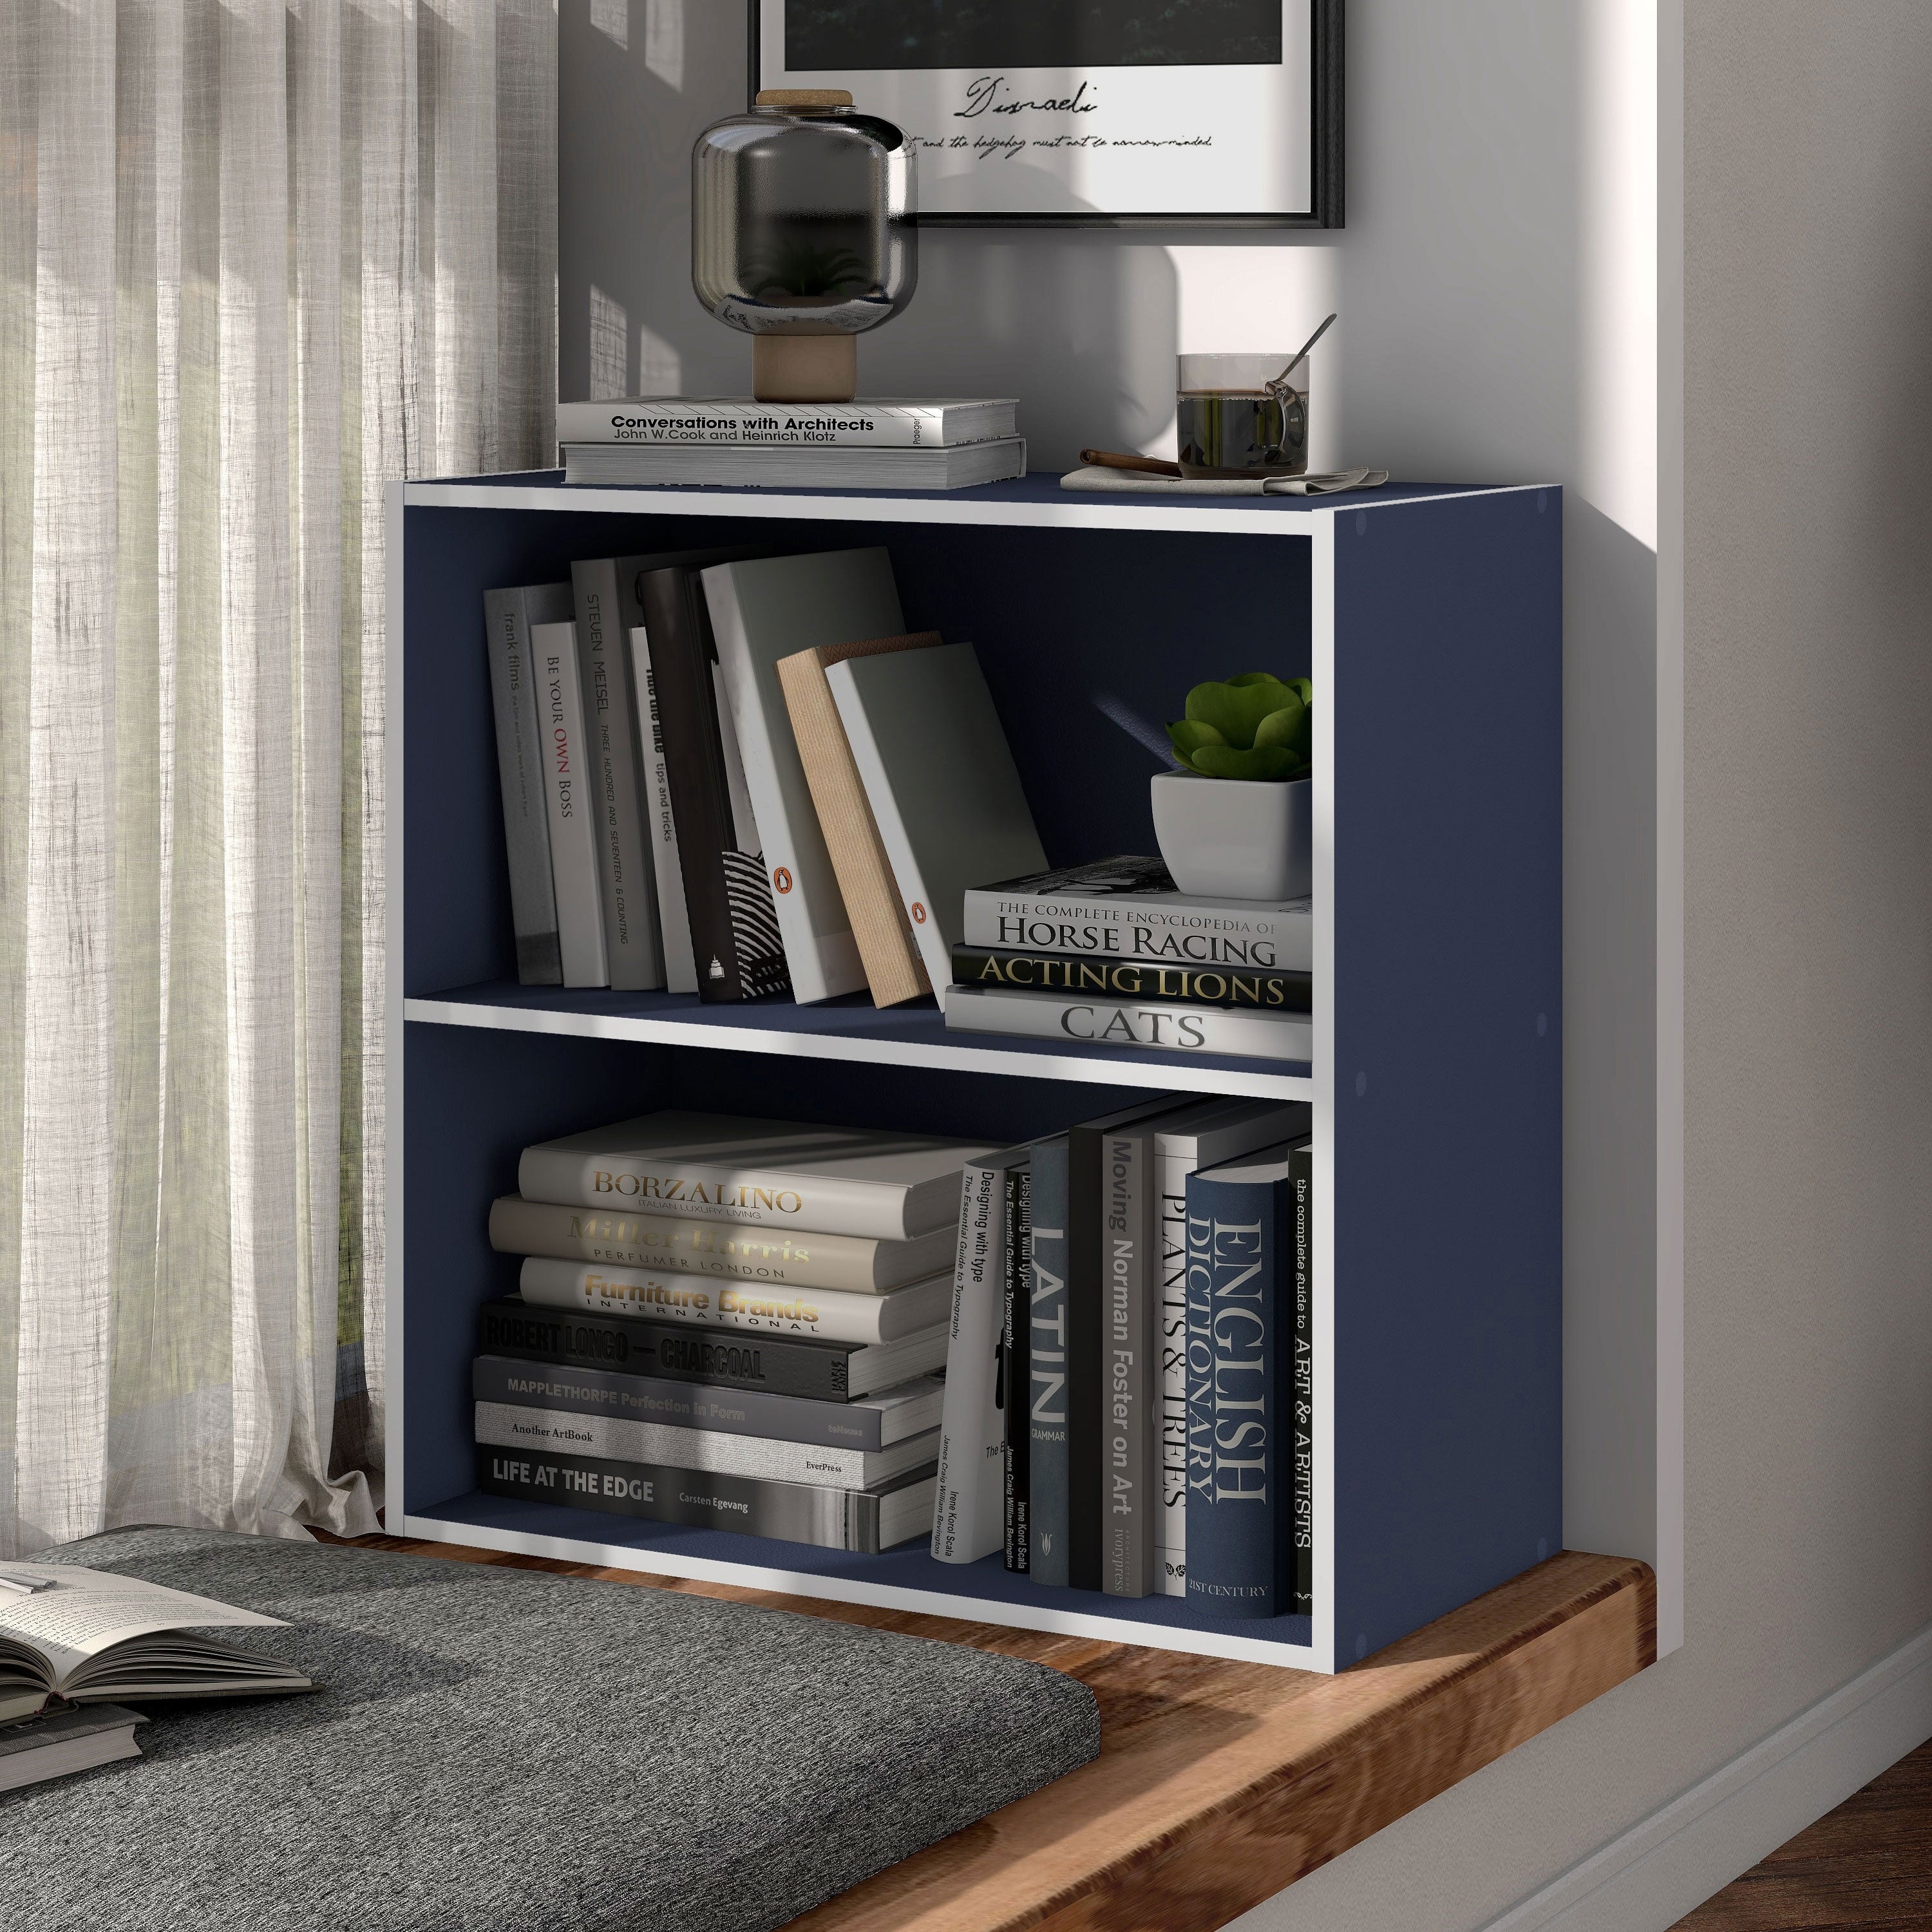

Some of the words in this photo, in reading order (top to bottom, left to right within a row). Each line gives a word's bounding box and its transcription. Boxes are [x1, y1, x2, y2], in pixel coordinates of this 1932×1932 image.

[923, 138, 944, 147] and
[948, 135, 969, 148] the
[974, 135, 1027, 160] hedgehog
[611, 415, 737, 429] Conversations
[743, 417, 779, 430] with
[784, 417, 874, 431] Architects
[614, 428, 647, 439] John
[651, 429, 706, 440] W.Cook
[710, 430, 737, 440] and
[742, 430, 799, 441] Heinrich
[804, 431, 837, 442] Klotz
[913, 418, 923, 445] Praeger
[504, 613, 518, 650] frank
[587, 593, 603, 652] STEVEN
[508, 654, 520, 691] films
[547, 656, 560, 674] BE
[549, 679, 564, 724] YOUR
[593, 661, 609, 716] MEISEL
[553, 728, 570, 773] OWN
[601, 724, 611, 753] THREE
[656, 762, 665, 784] tips
[558, 780, 573, 818] BOSS
[659, 787, 669, 807] and
[608, 806, 617, 826] AND
[662, 811, 672, 842] tricks
[610, 829, 622, 884] SEVENTEEN
[997, 902, 1029, 914] THE
[1035, 904, 1119, 922] COMPLETE
[1126, 911, 1251, 933] ENCYCLOPEDIA
[1256, 922, 1278, 935] OF
[997, 916, 1120, 952] HORSE
[1131, 926, 1277, 967] RACING
[977, 955, 1142, 993] ACTING
[1156, 969, 1285, 1005] LIONS
[1060, 1006, 1206, 1048] CATS
[592, 1171, 802, 1213] BORZALINO
[965, 1175, 973, 1193] The
[1108, 1141, 1132, 1232] Moving
[1296, 1179, 1306, 1202] the
[638, 1199, 677, 1210] ITALIAN
[680, 1203, 723, 1215] LUXURY
[726, 1208, 761, 1219] LIVING
[975, 1171, 995, 1229] Designing
[961, 1195, 971, 1239] Essential
[567, 1215, 679, 1248] Miller
[689, 1227, 810, 1264] Harris
[974, 1231, 989, 1255] with
[1296, 1205, 1306, 1269] complete
[594, 1249, 690, 1268] PERFUMER
[701, 1261, 785, 1278] LONDON
[958, 1240, 967, 1269] Guide
[971, 1258, 987, 1282] type
[1006, 1248, 1014, 1276] Guide
[1162, 1191, 1186, 1338] PLANTS
[957, 1271, 963, 1281] to
[1006, 1278, 1012, 1289] to
[1113, 1239, 1133, 1341] Norman
[585, 1274, 709, 1309] Furniture
[718, 1289, 819, 1323] Brands
[1296, 1272, 1305, 1315] guide
[586, 1298, 820, 1332] INTERNATIONAL
[950, 1284, 963, 1340] Typography
[1005, 1291, 1014, 1349] Typography
[1031, 1226, 1066, 1423] LATIN
[1296, 1316, 1305, 1329] to
[487, 1316, 562, 1353] ROBERT
[565, 1325, 629, 1362] LONGO
[660, 1338, 766, 1383] CHARCOAL
[1162, 1347, 1186, 1377] &
[1188, 1213, 1213, 1505] DICTIONARY
[1214, 1217, 1267, 1505] ENGLISH
[507, 1378, 618, 1405] MAPPLETHORPE
[621, 1392, 690, 1414] Perfection
[694, 1401, 706, 1416] in
[710, 1404, 746, 1421] Form
[1113, 1349, 1133, 1430] Foster
[1296, 1400, 1311, 1424] &
[511, 1423, 551, 1437] Another
[552, 1427, 593, 1442] ArtBook
[942, 1435, 951, 1461] James
[1031, 1428, 1066, 1441] GRAMMAR
[1162, 1388, 1186, 1508] TREES
[806, 1461, 842, 1473] EverPress
[986, 1444, 999, 1459] The
[1113, 1436, 1128, 1467] on
[493, 1458, 531, 1484] LIFE
[534, 1464, 558, 1488] AT
[562, 1469, 598, 1495] THE
[603, 1475, 654, 1502] EDGE
[1006, 1473, 1014, 1496] Craig
[1113, 1473, 1133, 1515] Art
[1295, 1431, 1311, 1549] ARTISTS
[679, 1492, 711, 1506] Carsten
[712, 1497, 748, 1514] Egevang
[938, 1485, 947, 1514] William
[949, 1491, 959, 1511] Irene
[1006, 1497, 1014, 1526] William
[1018, 1501, 1027, 1522] Irene
[934, 1515, 943, 1554] Bevington
[947, 1513, 957, 1533] Korol
[1018, 1523, 1027, 1545] Korol
[945, 1535, 954, 1557] Scala
[1006, 1528, 1014, 1567] Bevington
[1018, 1546, 1027, 1569] Scala
[1112, 1529, 1124, 1592] ivorypress
[1208, 1584, 1269, 1597] CENTURY
